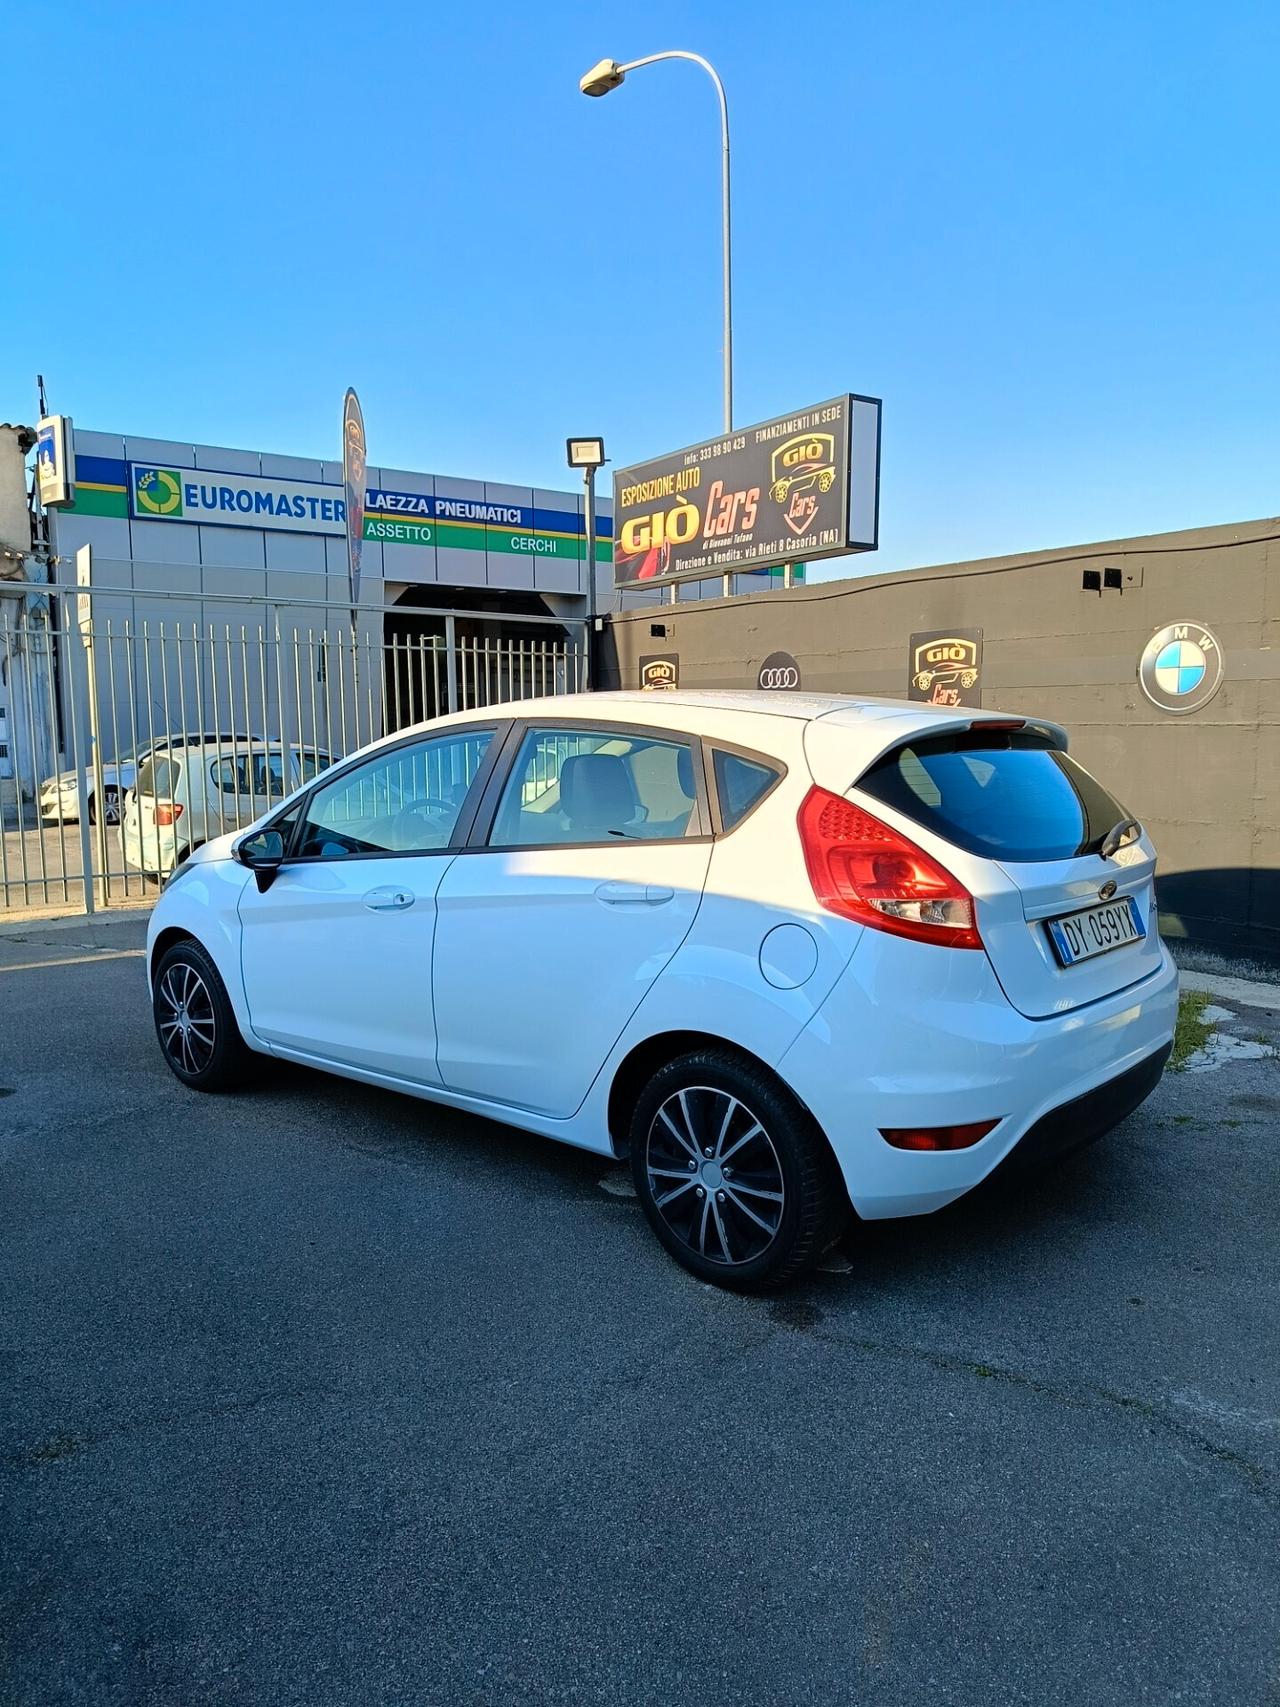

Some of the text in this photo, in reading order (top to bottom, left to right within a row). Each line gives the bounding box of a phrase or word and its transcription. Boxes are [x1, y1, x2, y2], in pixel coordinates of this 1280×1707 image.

[755, 405, 842, 443] FINANZIAMENTI IN SEDE
[699, 447, 712, 461] 333
[783, 438, 824, 467] GIÒ
[184, 483, 347, 523] EUROMASTER
[621, 466, 701, 508] ESPOSIZIONE AUTO
[365, 492, 522, 524] LAEZZA PNEUMATICI
[702, 480, 761, 538] Cars
[788, 492, 816, 519] Cars
[366, 522, 557, 554] ASSETTO CERCHI
[620, 494, 701, 555] GIÒ
[675, 556, 706, 571] Direzione
[786, 533, 817, 550] Casoria
[932, 683, 959, 705] Cars
